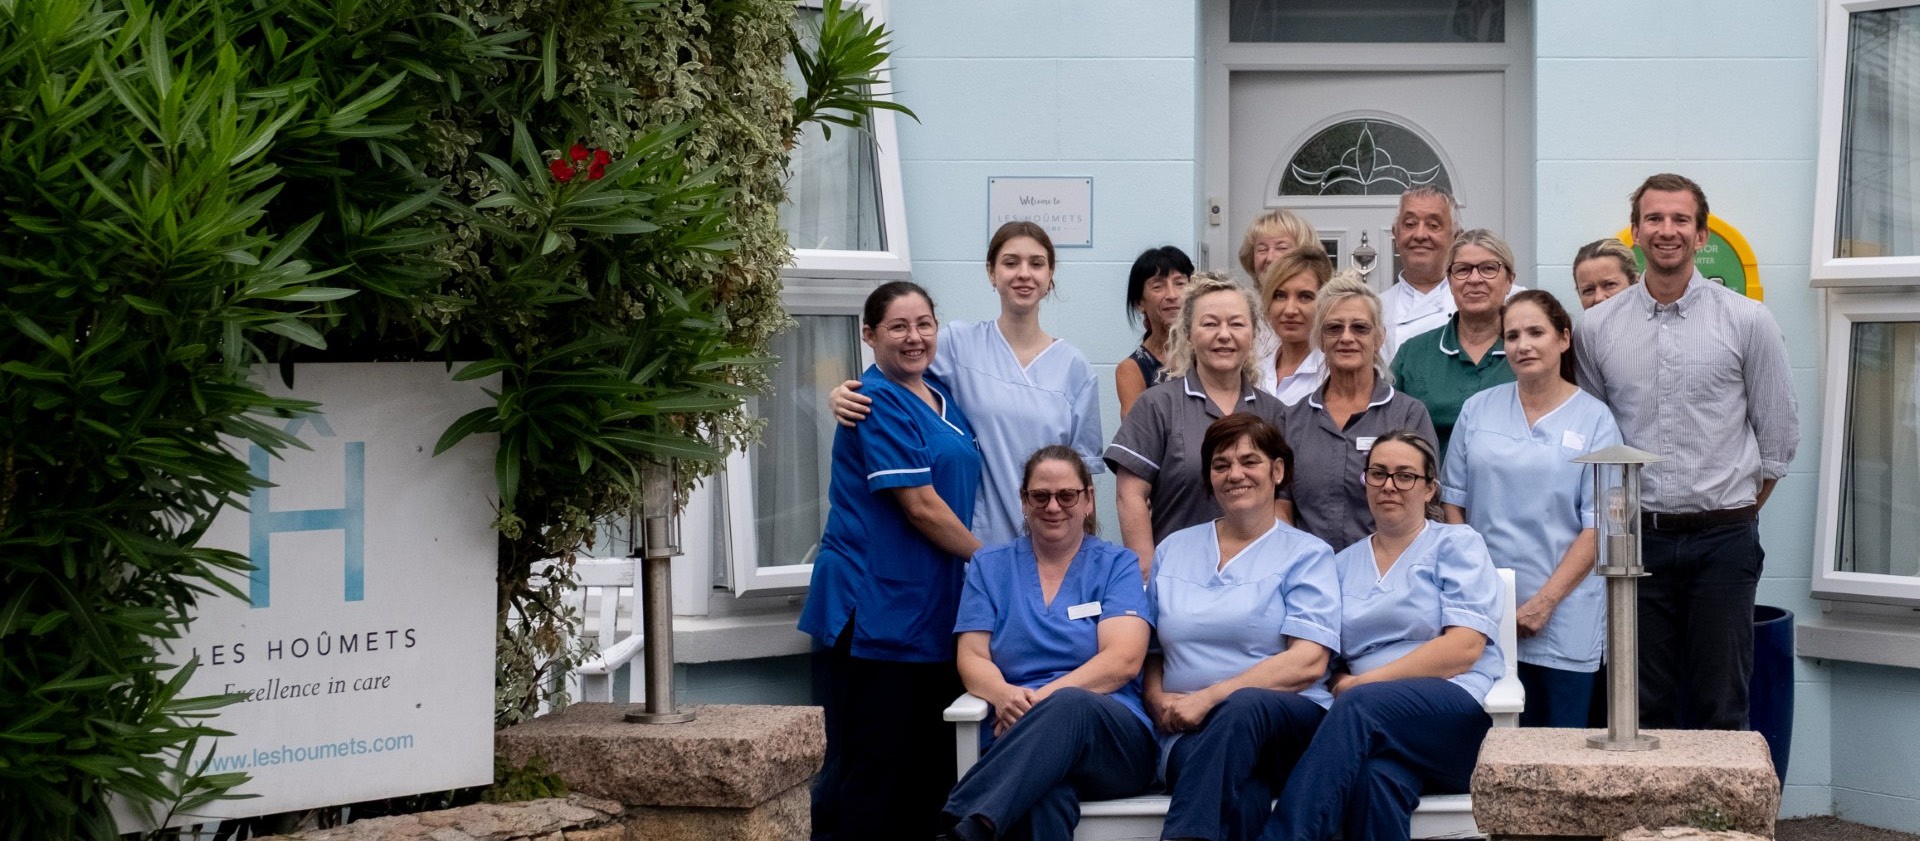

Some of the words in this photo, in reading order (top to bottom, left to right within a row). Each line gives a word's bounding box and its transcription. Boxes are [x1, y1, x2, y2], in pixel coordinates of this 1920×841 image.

[1019, 195, 1051, 206] Welcome
[1053, 197, 1061, 206] to
[998, 214, 1018, 223] LES
[193, 643, 245, 666] LES
[267, 628, 416, 660] HOÛMETS
[224, 677, 320, 703] Ecellence
[327, 676, 346, 694] in
[353, 675, 391, 691] care
